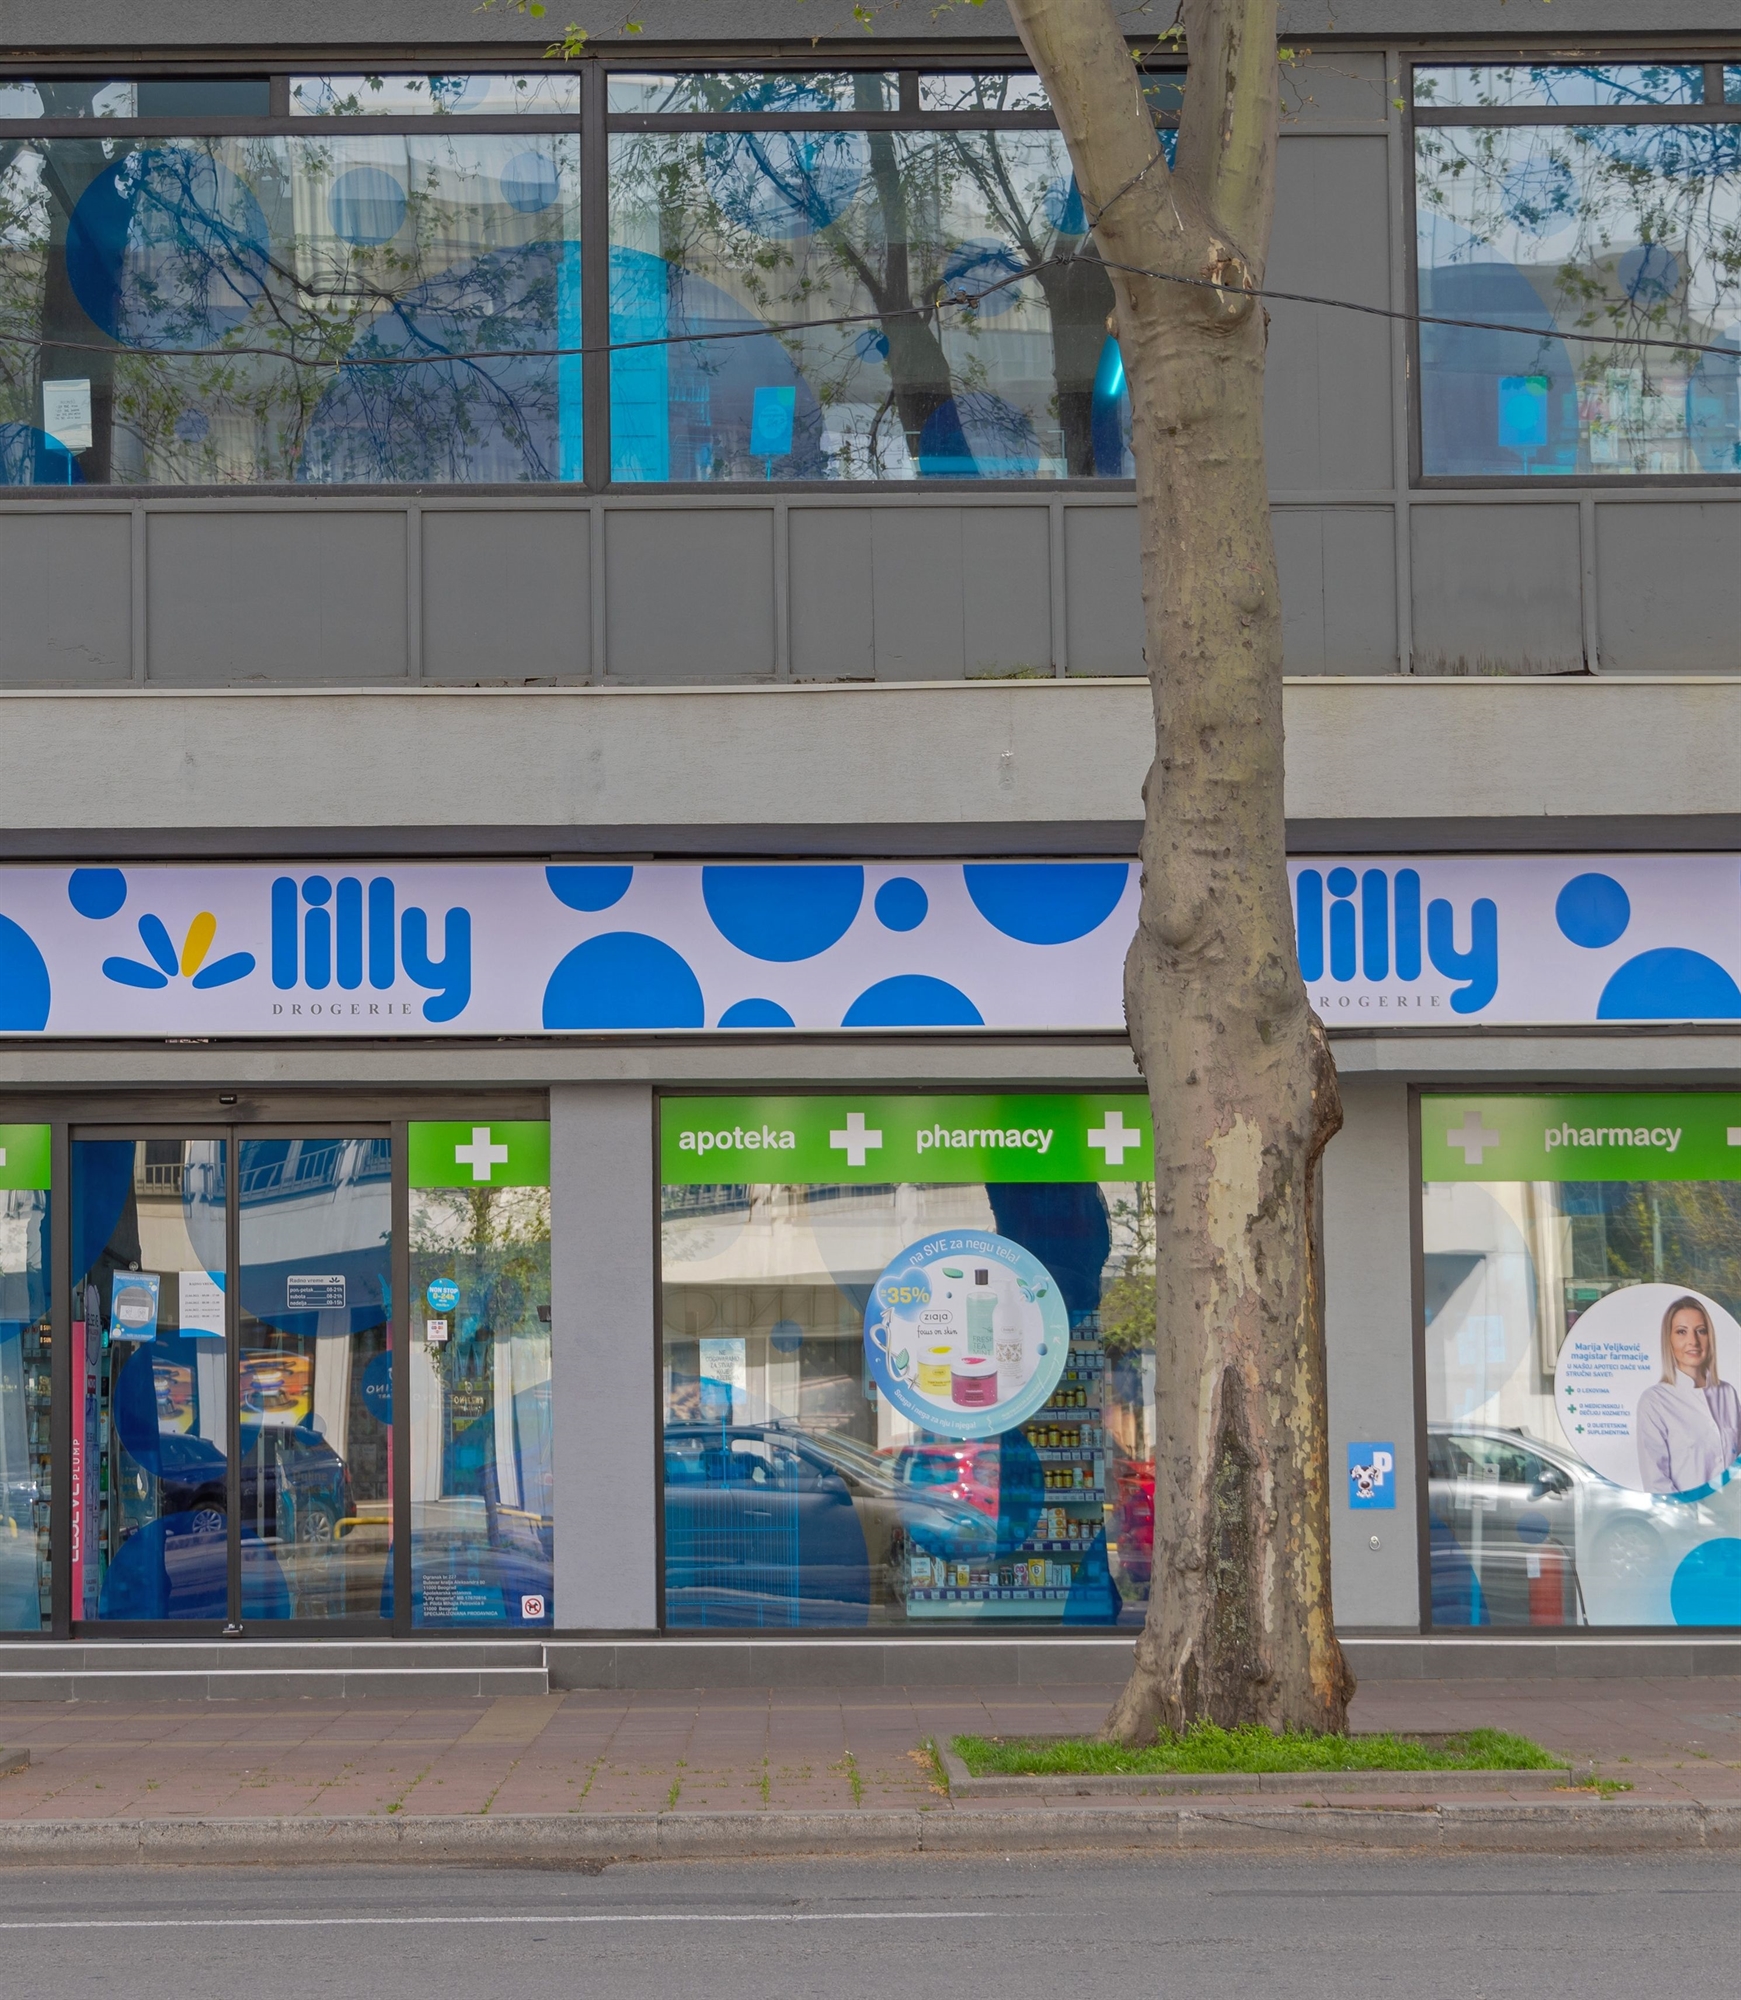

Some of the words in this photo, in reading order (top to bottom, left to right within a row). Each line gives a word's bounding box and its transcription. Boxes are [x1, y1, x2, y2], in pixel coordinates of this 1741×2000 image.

[272, 875, 471, 1023] lilly
[1297, 867, 1499, 1014] lilly
[272, 1002, 414, 1016] DROGERIE
[679, 1125, 796, 1156] apoteka
[916, 1123, 1054, 1154] pharmacy
[1544, 1122, 1682, 1153] pharmacy
[909, 1252, 924, 1265] na
[923, 1239, 948, 1257] SVE
[950, 1239, 963, 1249] za
[966, 1239, 994, 1253] negu
[995, 1245, 1021, 1265] tela!
[1570, 1351, 1608, 1361] magistar
[1609, 1351, 1650, 1362] farmacije
[1574, 1342, 1602, 1352] Marija
[1602, 1342, 1641, 1352] Veljković
[1373, 1451, 1393, 1486] P
